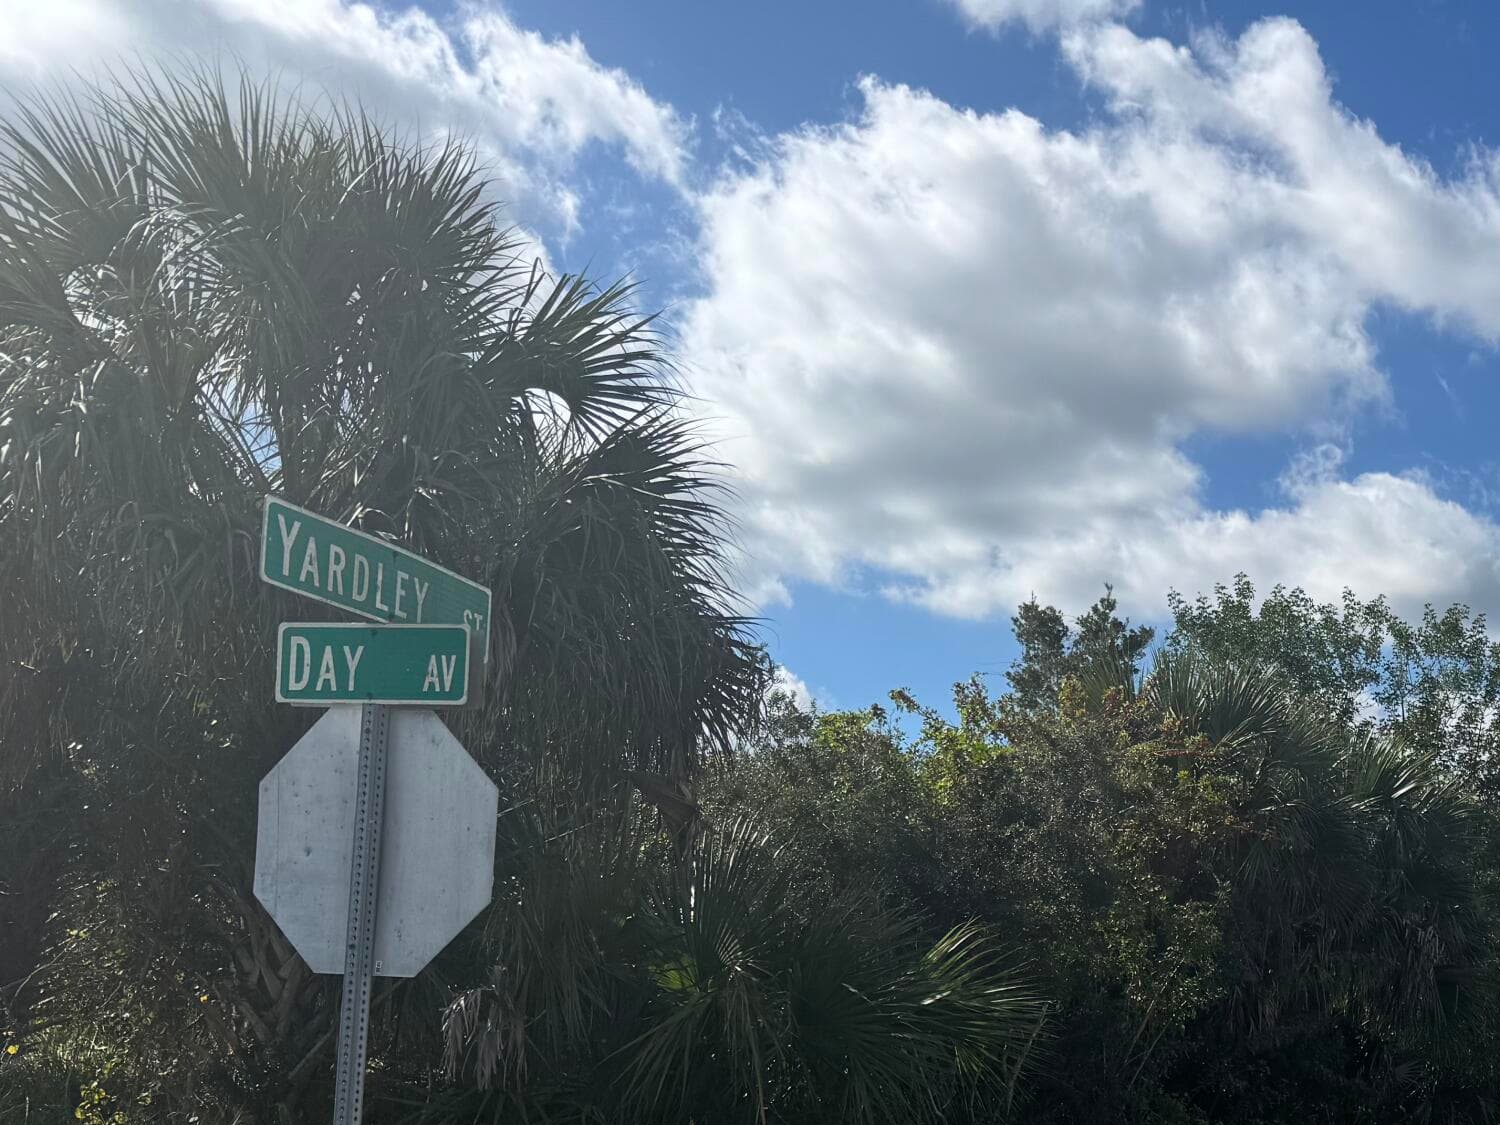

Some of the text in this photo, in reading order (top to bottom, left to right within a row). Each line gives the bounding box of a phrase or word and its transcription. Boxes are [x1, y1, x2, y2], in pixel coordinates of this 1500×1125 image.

[278, 513, 483, 631] YARDLEY ST
[288, 636, 457, 692] DAY AV
